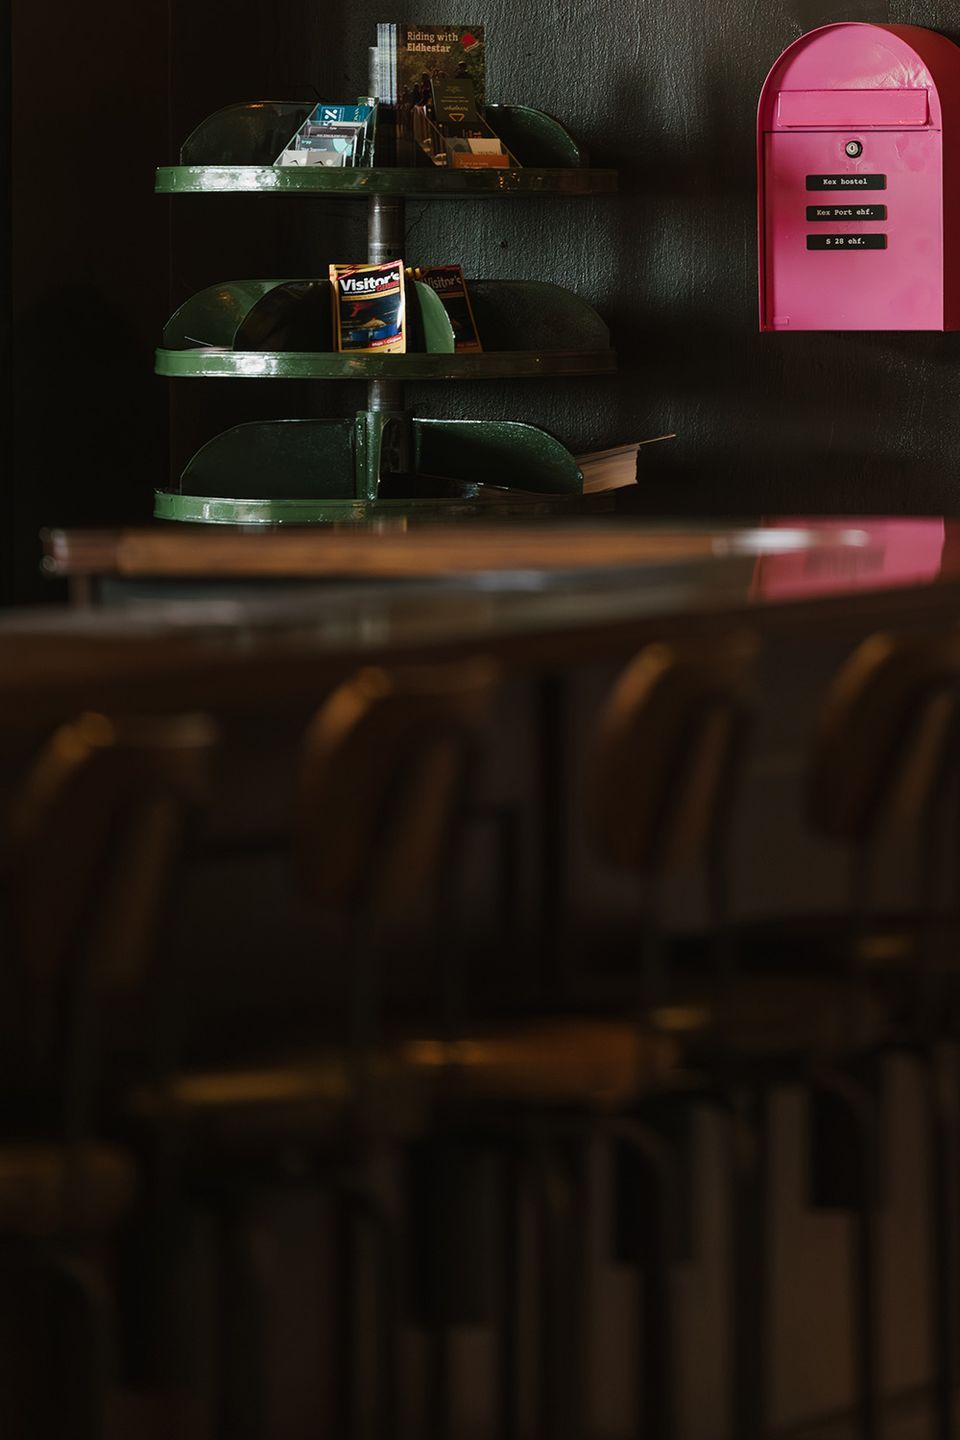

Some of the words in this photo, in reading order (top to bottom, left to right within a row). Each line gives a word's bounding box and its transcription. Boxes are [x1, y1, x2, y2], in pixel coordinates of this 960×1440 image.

[407, 31, 435, 43] Riding
[437, 31, 459, 42] with
[407, 42, 451, 53] Eldhestar
[856, 208, 874, 216] ehf.
[834, 237, 844, 245] 28
[848, 237, 865, 245] ehf.
[340, 271, 400, 292] Visitor's
